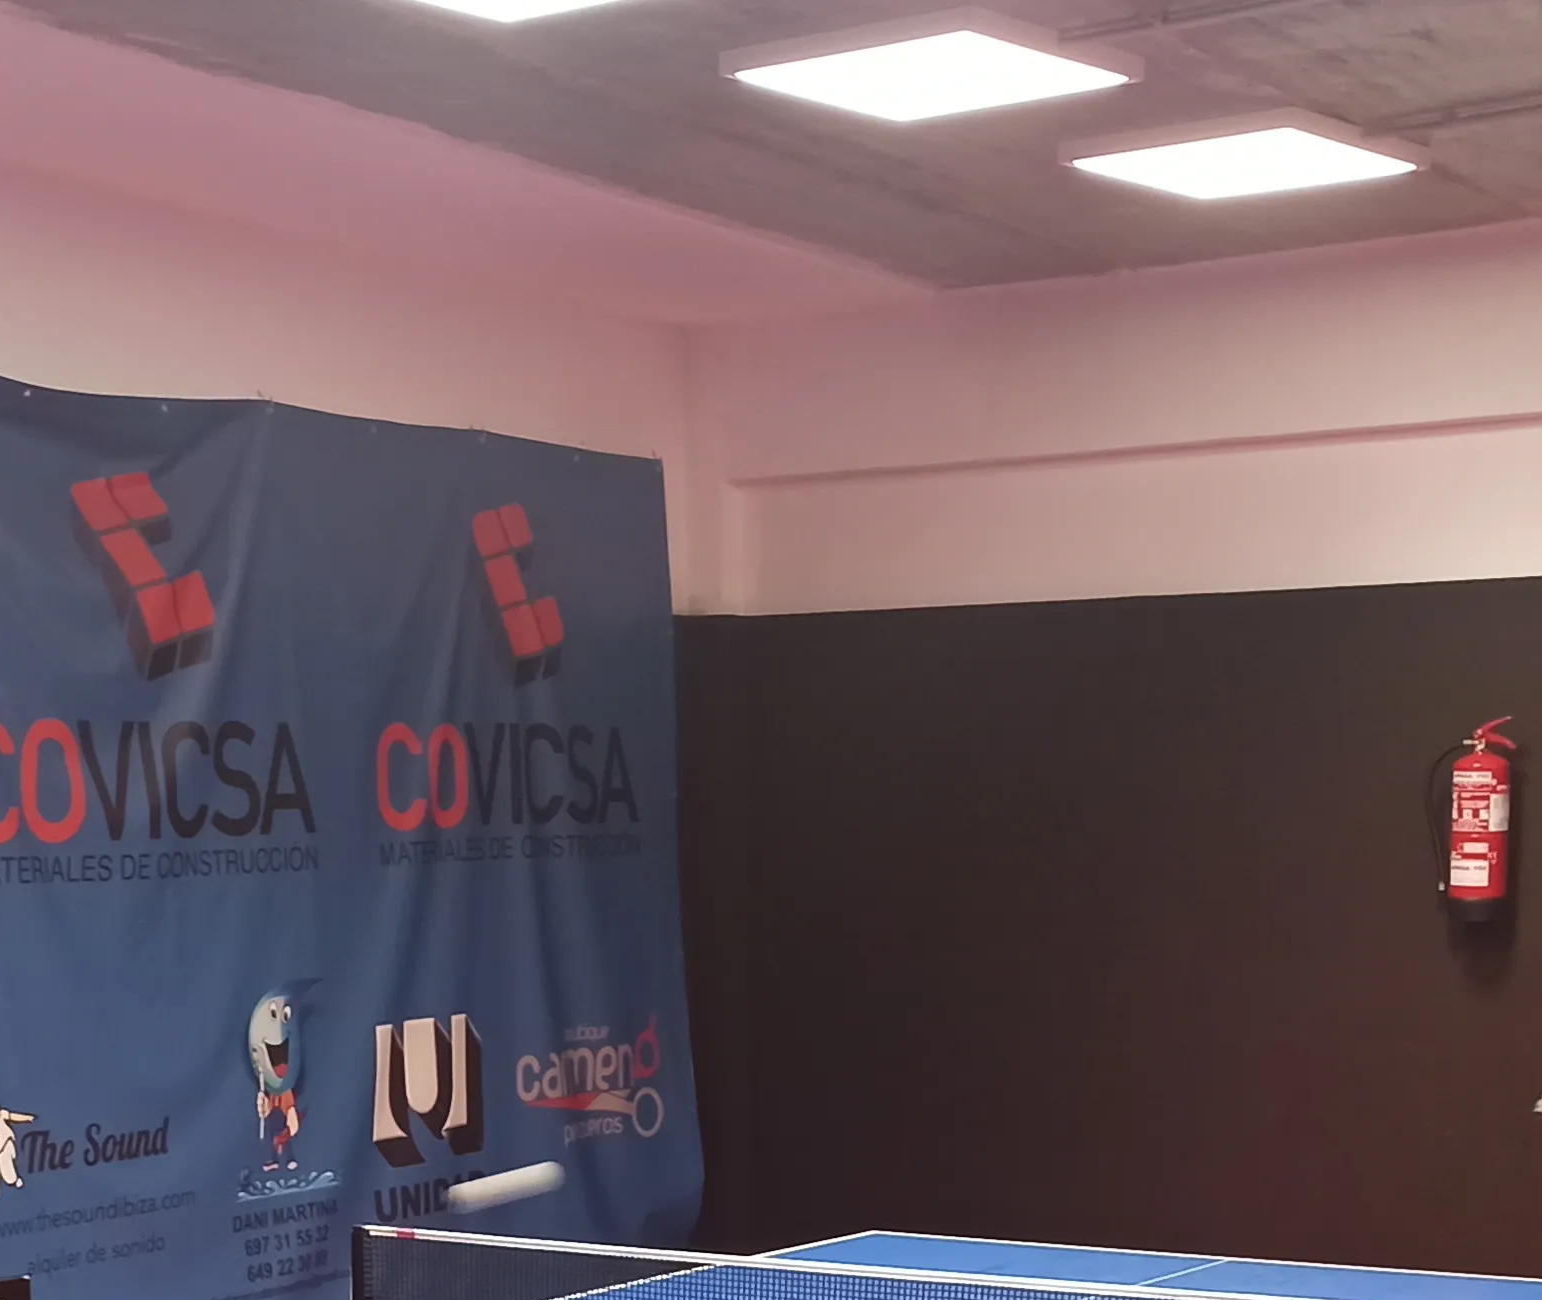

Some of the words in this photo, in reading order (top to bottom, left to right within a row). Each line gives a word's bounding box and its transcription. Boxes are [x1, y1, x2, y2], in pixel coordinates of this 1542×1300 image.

[376, 722, 640, 832] COVICSA
[121, 853, 152, 881] DE
[21, 1129, 74, 1174] The
[83, 1115, 169, 1167] Sound
[374, 1170, 487, 1223] UNID
[233, 1210, 269, 1233] DANI
[85, 1242, 107, 1264] de
[111, 1230, 166, 1259] sonido
[277, 1258, 294, 1276] 22
